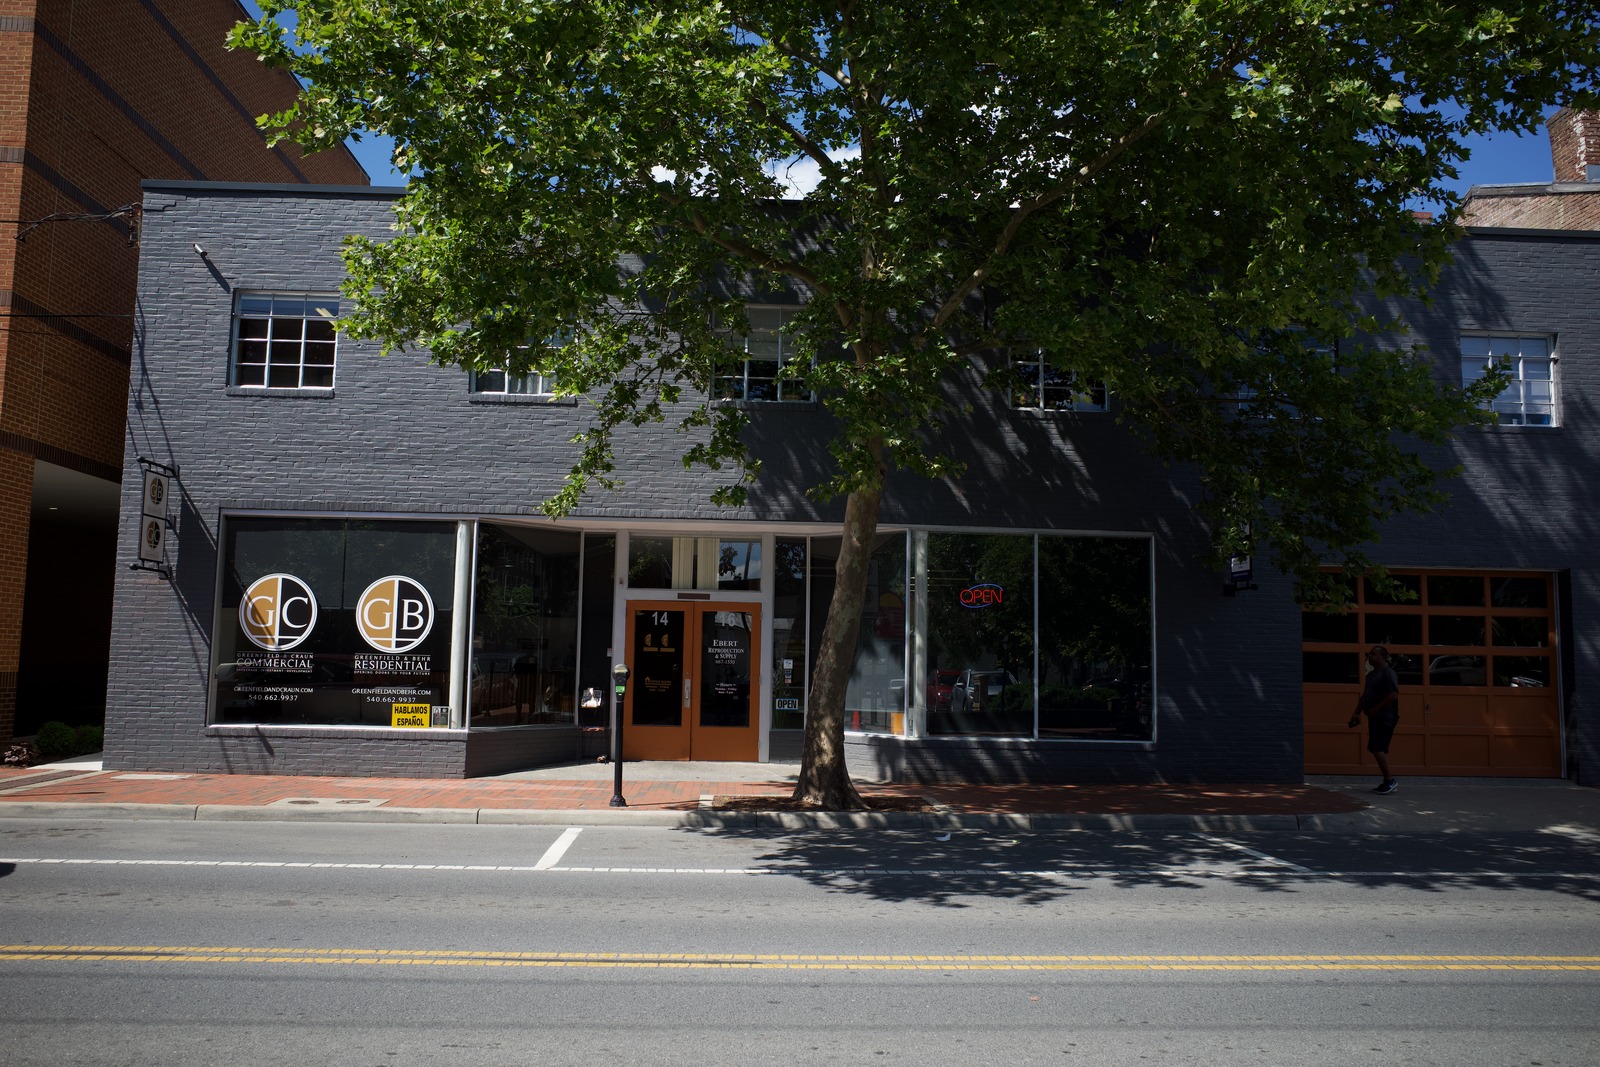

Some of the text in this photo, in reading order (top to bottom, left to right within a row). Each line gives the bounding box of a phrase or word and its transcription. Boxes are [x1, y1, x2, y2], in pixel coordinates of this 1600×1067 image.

[960, 589, 1003, 604] OPEN
[652, 611, 668, 625] 14
[719, 612, 736, 627] 16
[236, 658, 313, 668] COMMERCIAL
[354, 660, 431, 671] RESIDENTIAL
[777, 699, 797, 709] OPEN
[394, 706, 428, 715] HABLAMOS
[397, 715, 424, 726] ESPAÑOL
